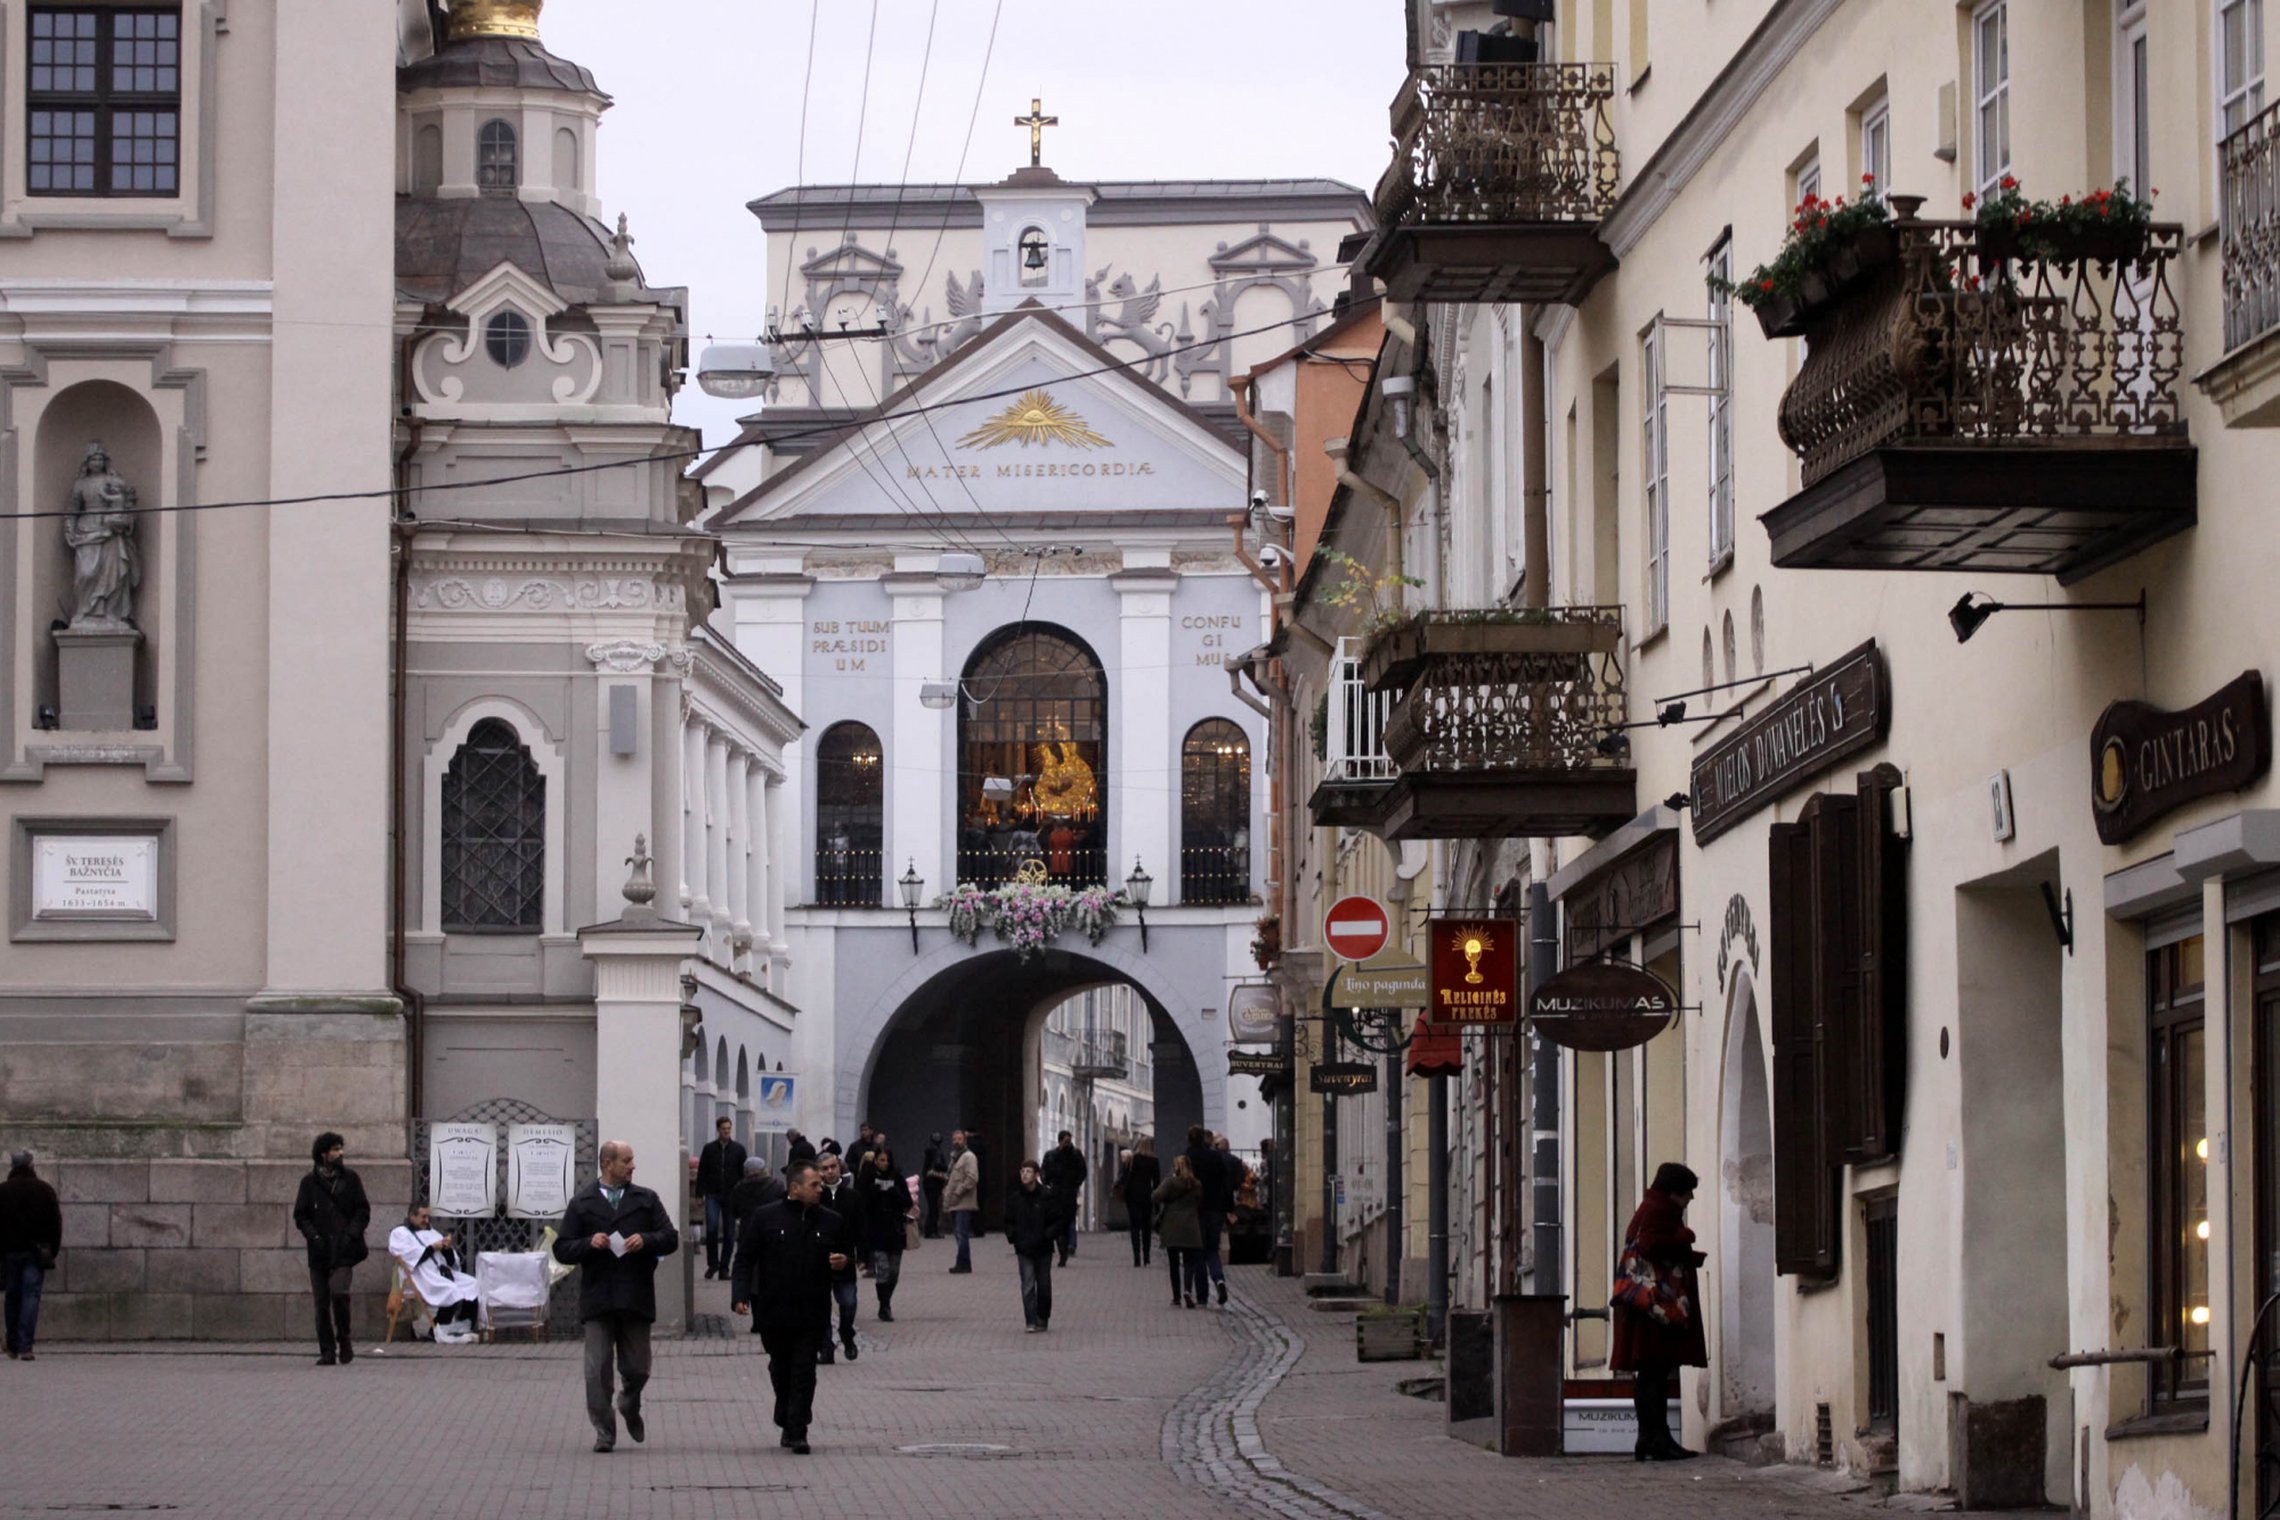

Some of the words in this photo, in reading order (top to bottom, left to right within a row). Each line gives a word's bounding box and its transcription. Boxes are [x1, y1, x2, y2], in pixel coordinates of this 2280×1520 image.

[907, 465, 981, 478] MATER
[997, 462, 1156, 477] MISERICORDIÆ
[814, 621, 839, 633] SUB
[845, 621, 889, 633] TUUM
[1182, 616, 1241, 629] CONFU
[813, 640, 886, 653] PRÆSIDI
[1202, 634, 1221, 647] GI
[836, 659, 865, 671] UM
[1756, 692, 1825, 781] DOVANĖLĖS
[2140, 708, 2235, 791] GINTARAS
[82, 854, 124, 866] TERESĖS
[70, 866, 122, 877] BAŽNYČIA
[75, 887, 116, 897] Pastatyta
[1374, 978, 1425, 995] pagunda
[1536, 996, 1666, 1011] MUZIKUMAS
[1314, 1073, 1373, 1087] Suvenyrai
[1578, 1411, 1638, 1421] MUZIKUM
